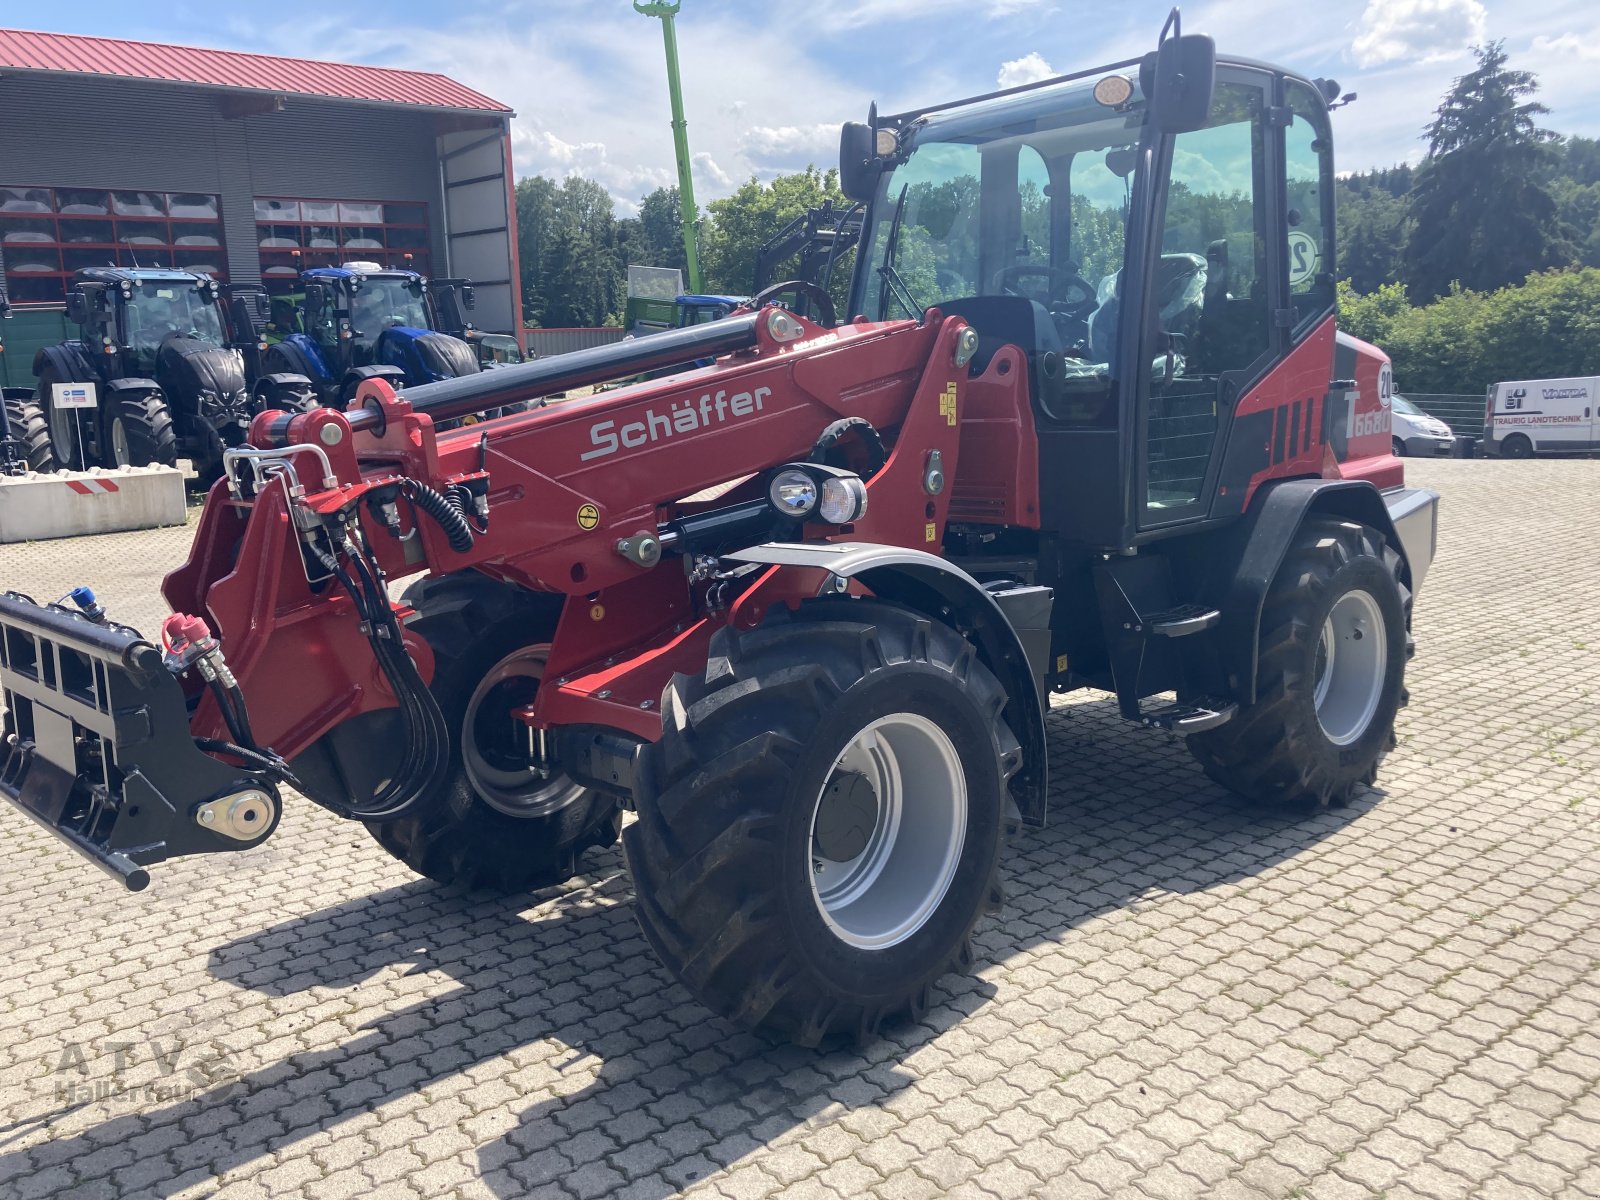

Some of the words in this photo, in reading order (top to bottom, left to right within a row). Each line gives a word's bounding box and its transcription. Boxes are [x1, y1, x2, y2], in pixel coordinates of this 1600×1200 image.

[1381, 371, 1391, 399] 20
[580, 386, 772, 461] Schäffer
[1494, 416, 1526, 425] TRAURIG
[1527, 415, 1582, 424] LANDTECHNIK
